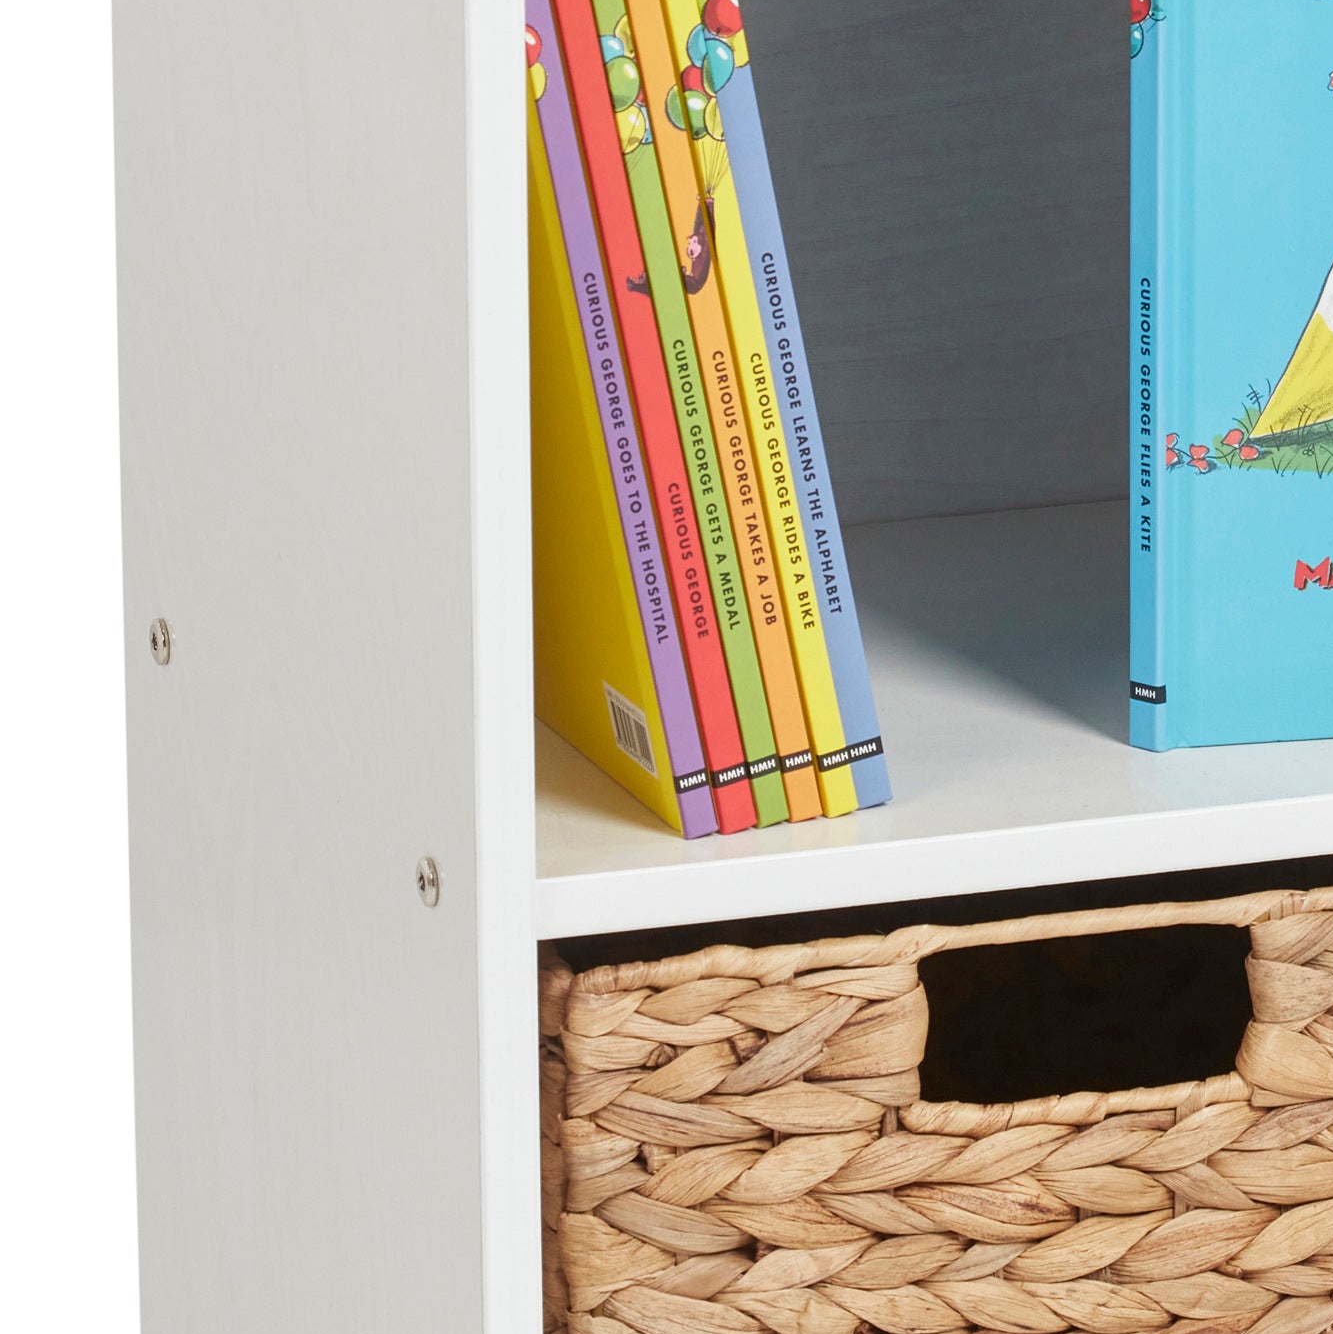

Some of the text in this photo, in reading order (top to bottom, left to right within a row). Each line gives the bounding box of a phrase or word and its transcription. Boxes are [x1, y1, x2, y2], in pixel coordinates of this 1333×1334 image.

[761, 252, 842, 614] CURIOUS GEORGE LEARNS THE ALPHABET
[1140, 277, 1151, 552] CURIOUS GEORGE FLIES A KITE
[583, 272, 669, 644] CURIOUS GEORGE GOES TO THE HOSPITAL
[673, 339, 741, 630] CURIOUS GEORGE GETS A MEDAL
[712, 350, 777, 625] CURIOUS GEORGE TAKES A JOB
[750, 353, 815, 629] CURIOUS GEORGE RIDES A BIKE
[668, 483, 709, 639] CURIOUS GEORGE
[1135, 686, 1156, 699] HMH
[679, 773, 706, 789] HMH
[719, 766, 745, 783] HMH
[750, 759, 776, 775] HMH
[785, 752, 812, 768] HMH
[823, 751, 849, 767] HMH
[850, 742, 877, 758] HMH
